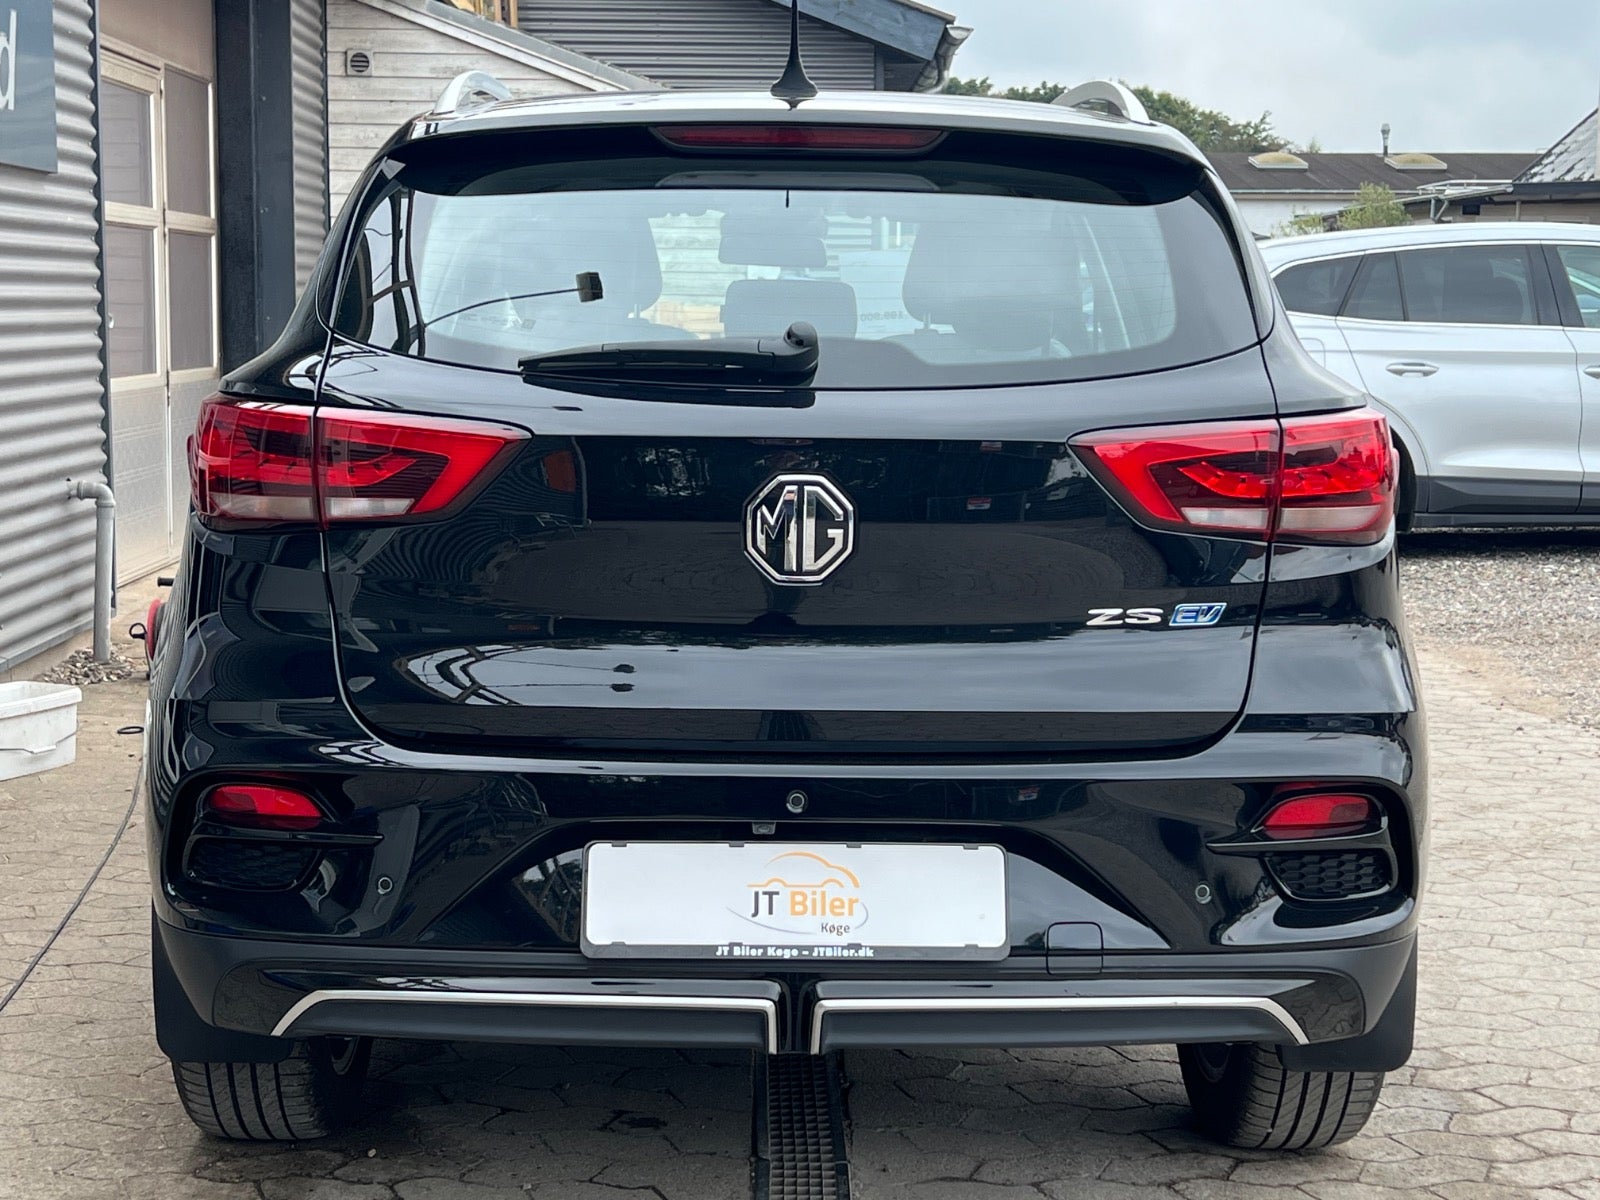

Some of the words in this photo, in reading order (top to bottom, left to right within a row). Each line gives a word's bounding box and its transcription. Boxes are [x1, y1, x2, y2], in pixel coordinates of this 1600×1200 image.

[757, 485, 844, 572] MG
[1086, 607, 1164, 626] ZS
[1173, 605, 1223, 624] EV
[751, 890, 780, 918] JT
[790, 890, 859, 917] Biler
[821, 922, 850, 936] Køge
[715, 946, 730, 956] JT
[733, 945, 763, 956] Biler
[812, 946, 874, 957] JTBiler.dk
